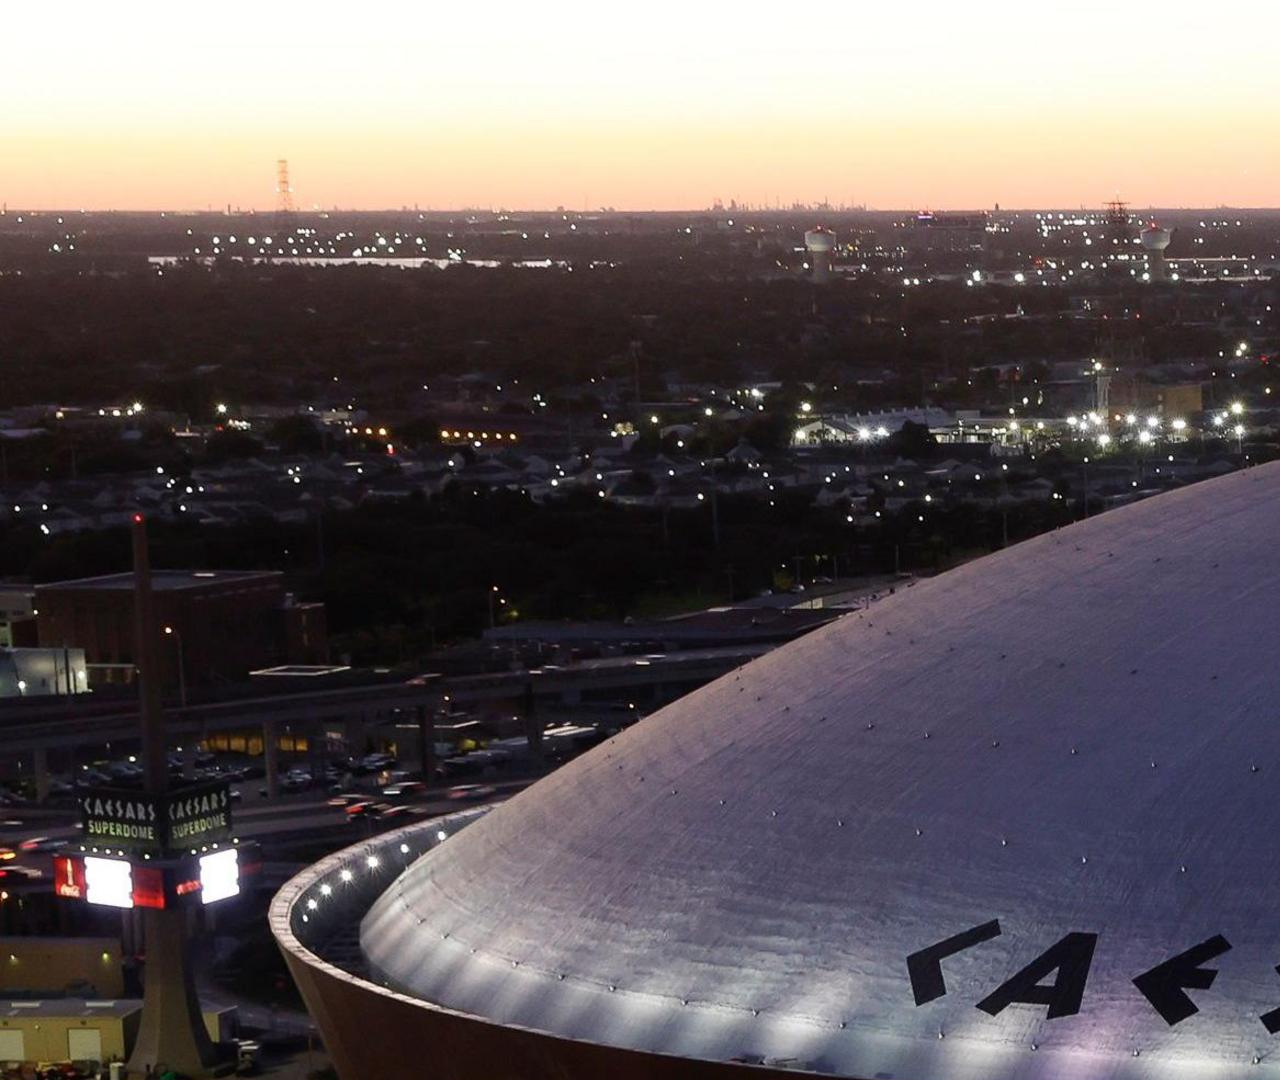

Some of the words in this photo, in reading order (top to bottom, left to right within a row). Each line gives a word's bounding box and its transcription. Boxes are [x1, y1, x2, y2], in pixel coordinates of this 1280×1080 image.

[84, 797, 155, 820] CAESARS
[168, 790, 227, 819] CAESARS
[88, 821, 154, 839] SUPERDOME
[172, 814, 226, 838] SUPERDOME
